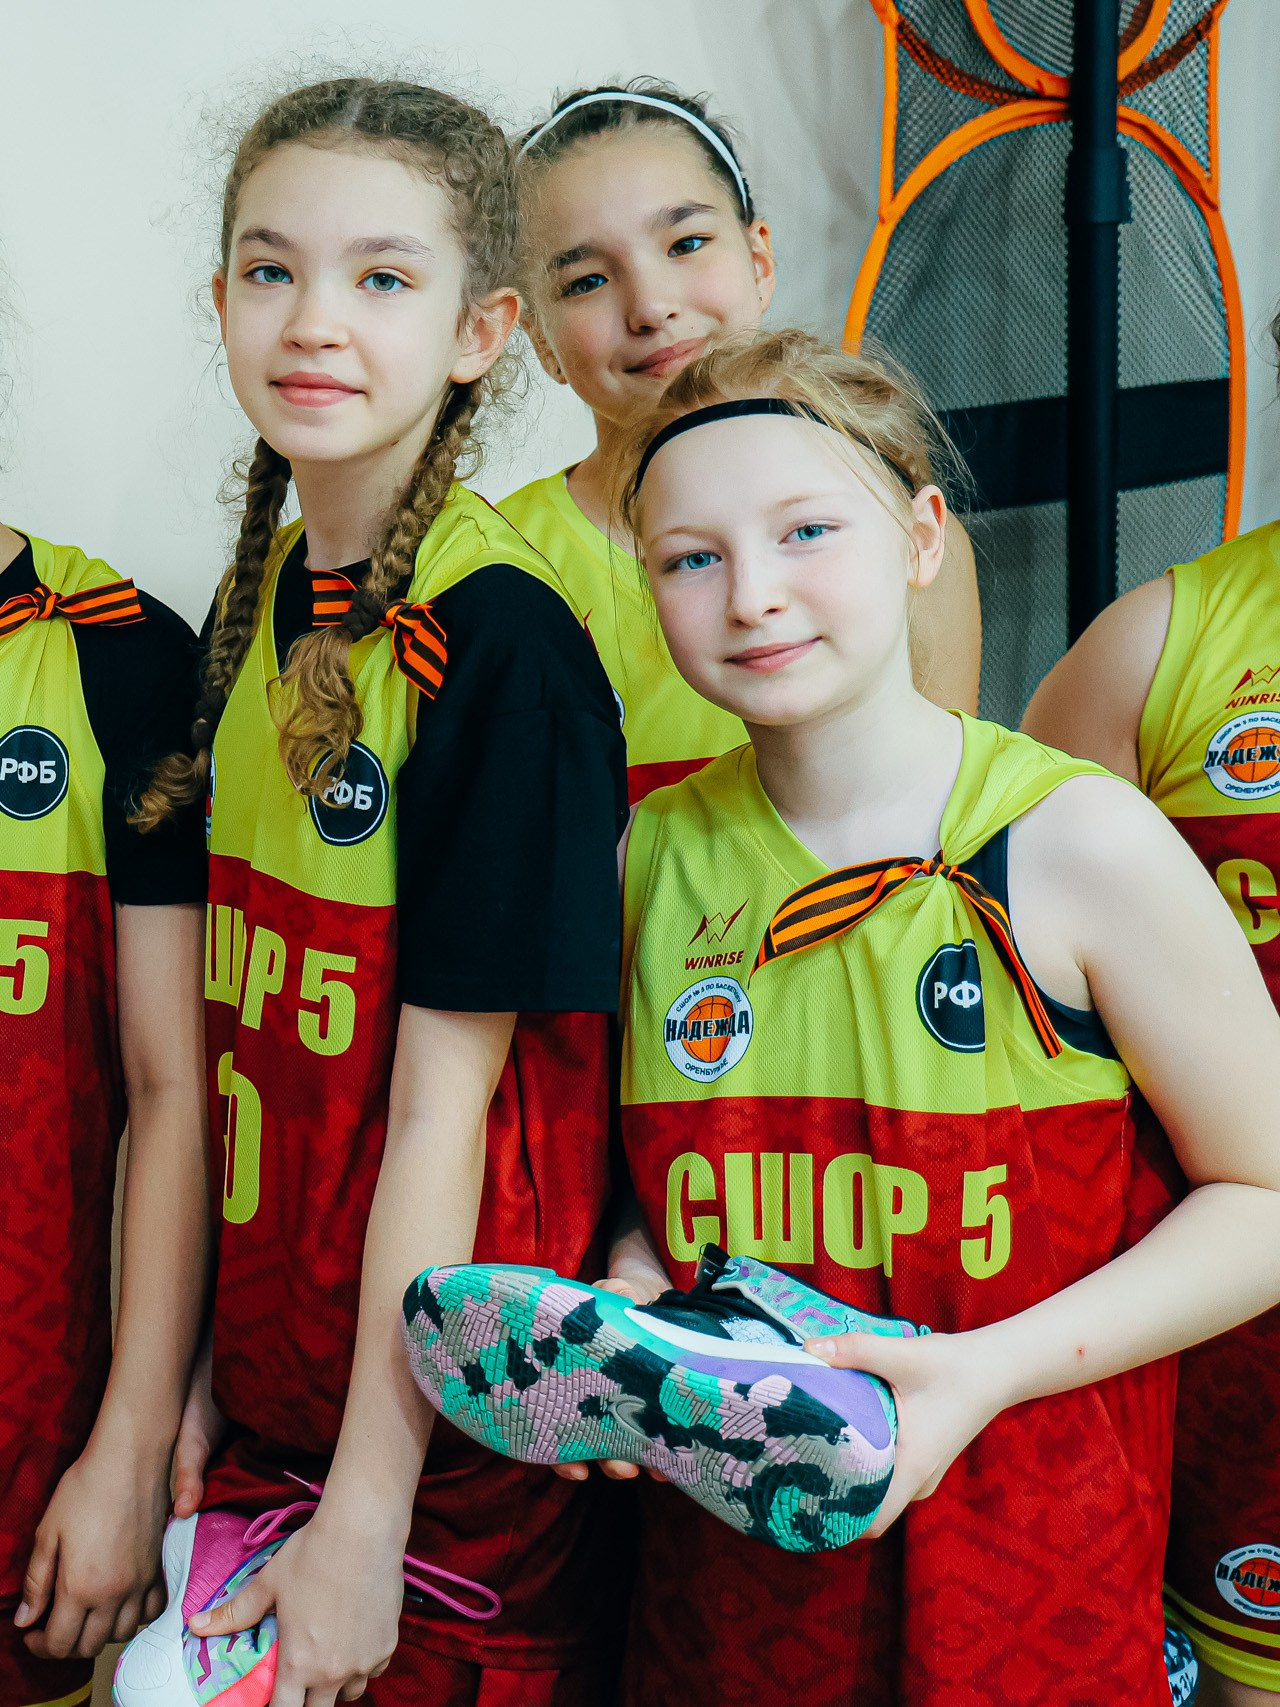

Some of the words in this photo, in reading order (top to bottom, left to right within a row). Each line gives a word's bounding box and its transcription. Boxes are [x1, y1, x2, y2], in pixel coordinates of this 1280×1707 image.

[0, 756, 57, 785] РФБ
[1204, 744, 1280, 769] НАДЕЖ
[684, 949, 745, 971] WINRISE
[298, 947, 357, 1056] 5
[933, 980, 982, 1009] РФ
[665, 1009, 750, 1043] НАДЕЖДА
[666, 1151, 929, 1278] СШОР
[960, 1164, 1012, 1280] 5
[1217, 1562, 1280, 1592] НАДЕЖ
